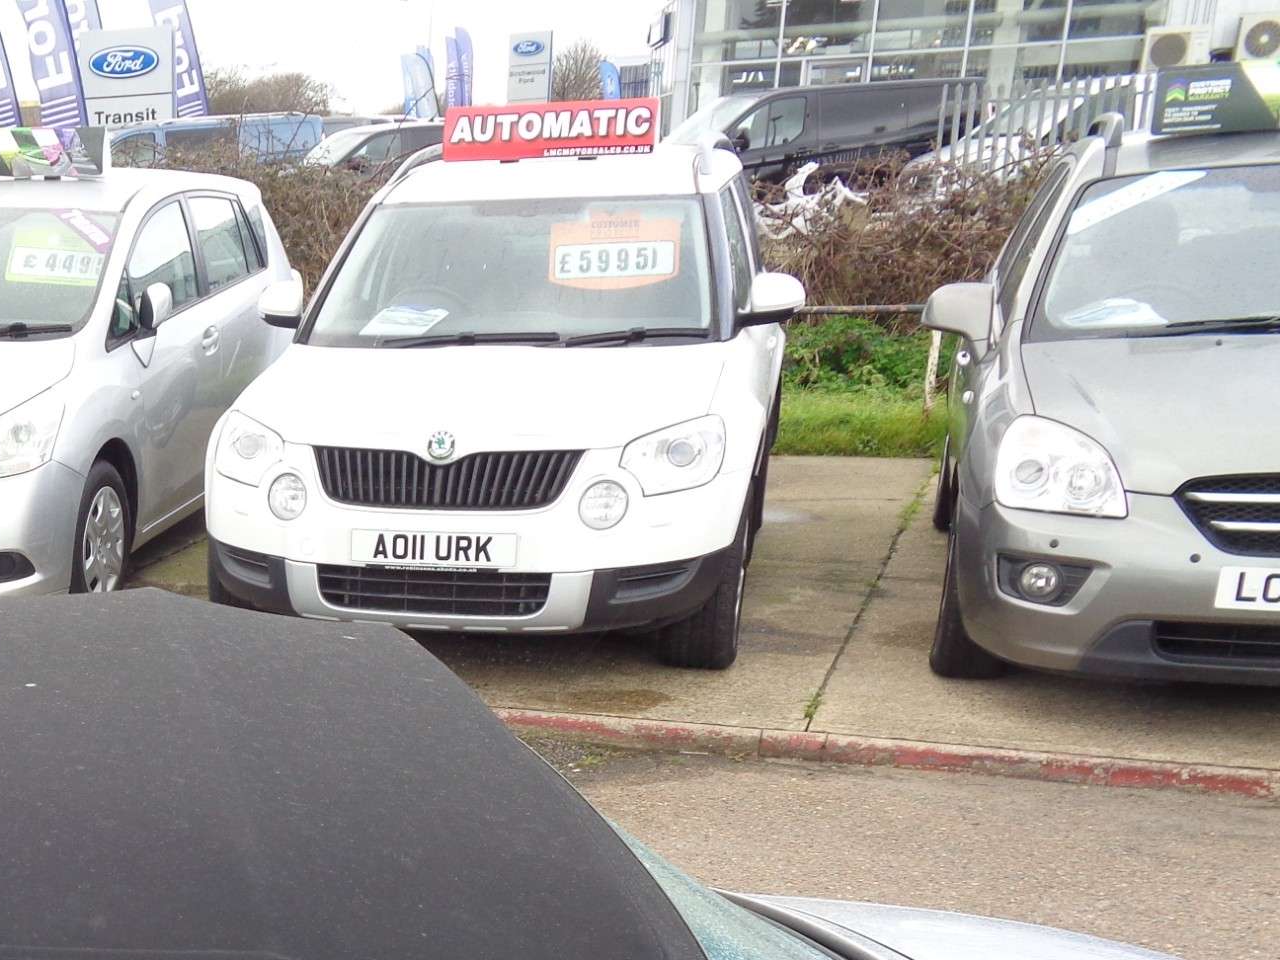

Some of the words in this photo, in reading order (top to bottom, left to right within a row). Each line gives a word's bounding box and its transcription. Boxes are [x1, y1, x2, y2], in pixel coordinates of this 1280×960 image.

[103, 51, 144, 72] Ford
[95, 108, 157, 125] Transit
[450, 107, 651, 144] AUTOMATIC
[373, 533, 425, 561] AO11
[435, 535, 493, 562] URK
